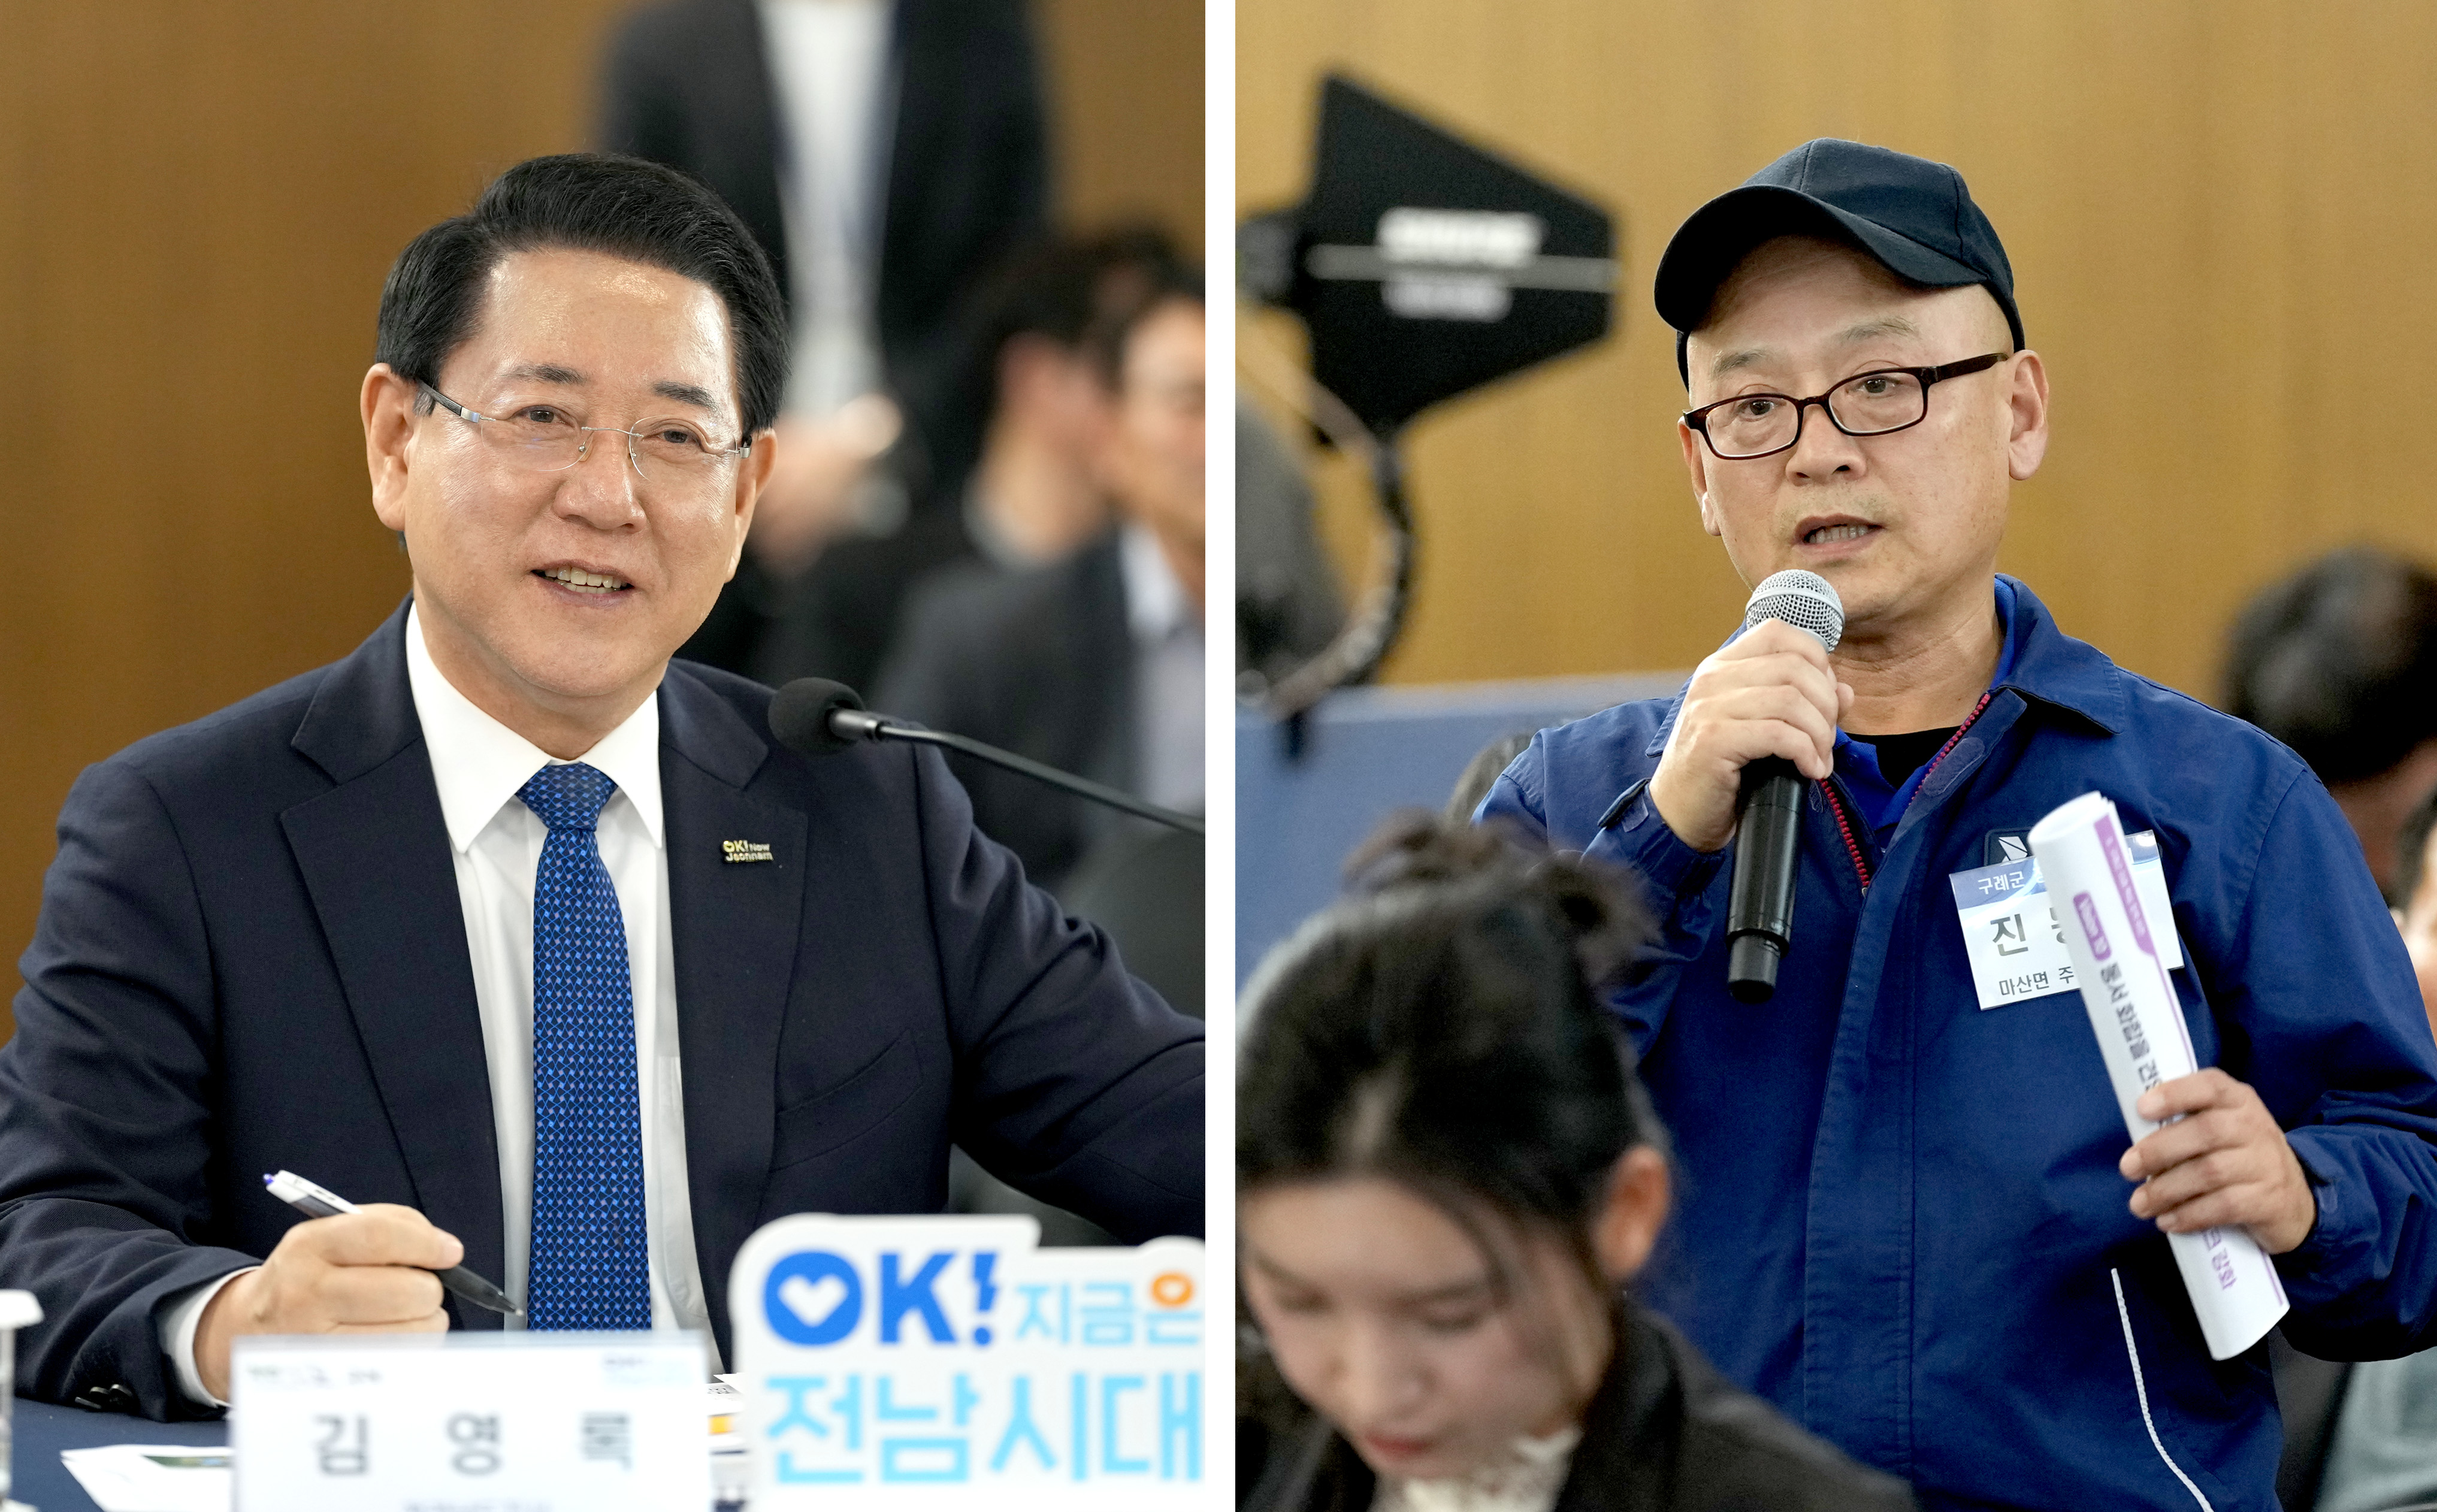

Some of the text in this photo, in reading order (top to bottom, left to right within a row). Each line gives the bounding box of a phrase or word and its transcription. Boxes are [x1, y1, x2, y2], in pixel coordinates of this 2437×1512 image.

[722, 840, 748, 853] OK!
[725, 852, 774, 862] Jeonnam
[1978, 871, 2025, 895] 구례군
[1990, 914, 2028, 957] 진
[1999, 966, 2074, 997] 마산면 주
[763, 1250, 1205, 1348] OK! 지금은
[763, 1372, 1205, 1483] 전남시대
